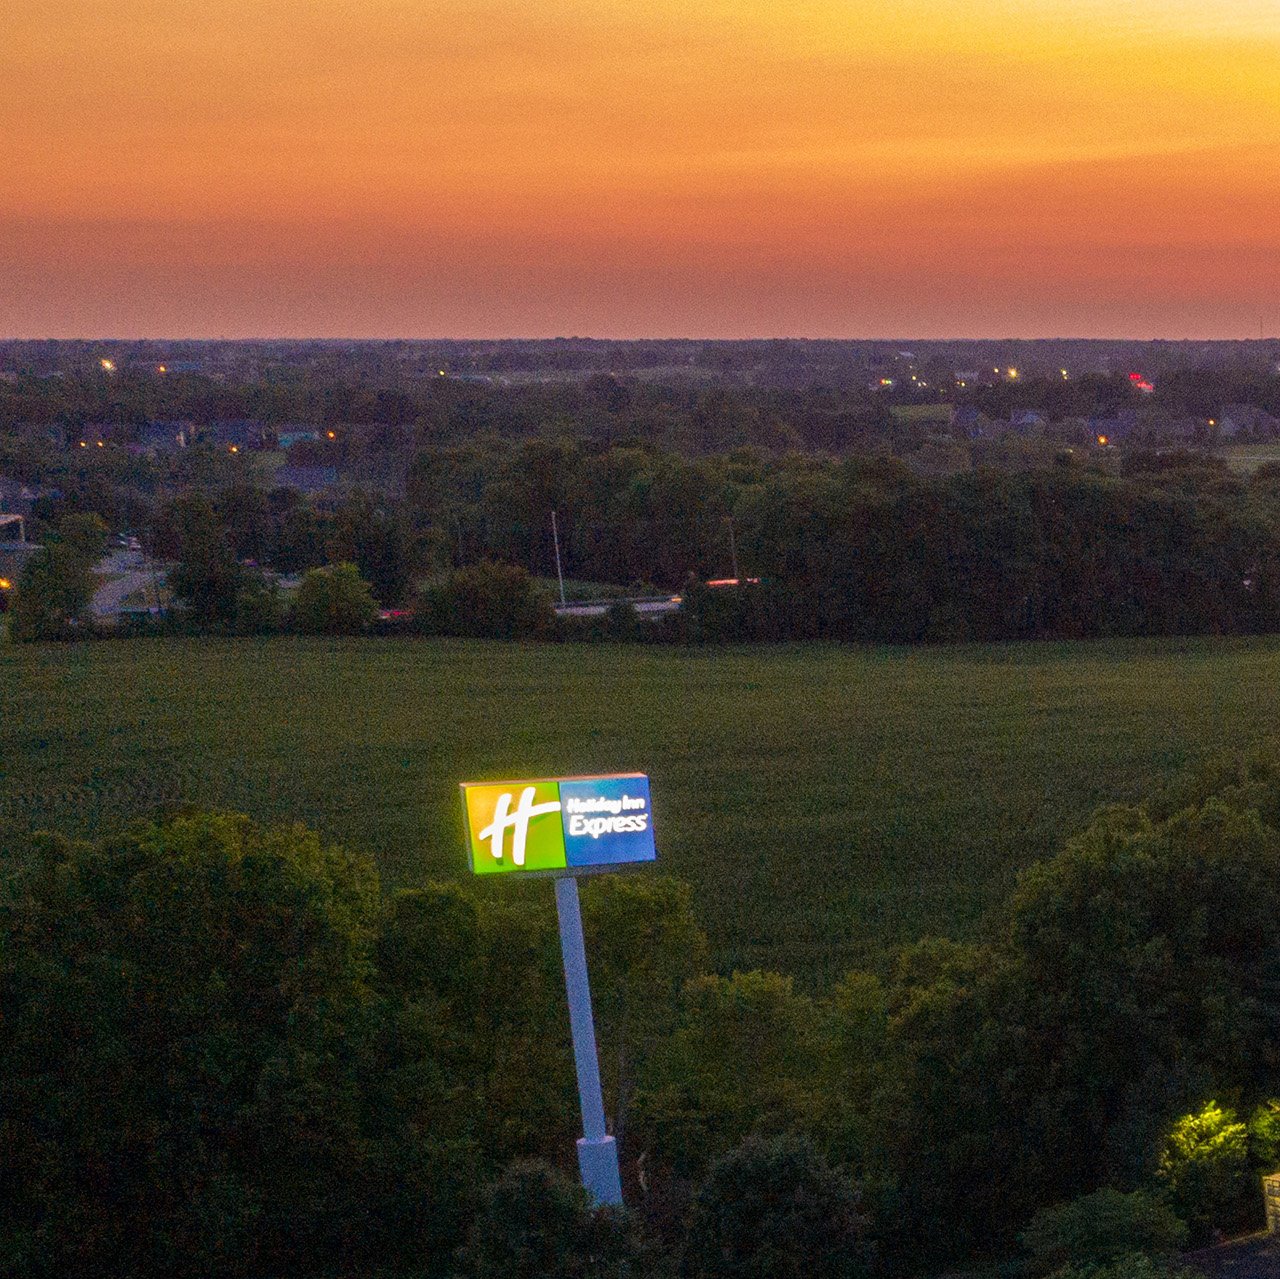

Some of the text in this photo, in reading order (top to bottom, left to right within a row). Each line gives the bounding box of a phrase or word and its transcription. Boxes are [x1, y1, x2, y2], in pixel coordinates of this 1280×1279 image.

[567, 795, 645, 814] Holiday Inn
[569, 814, 647, 838] Express
